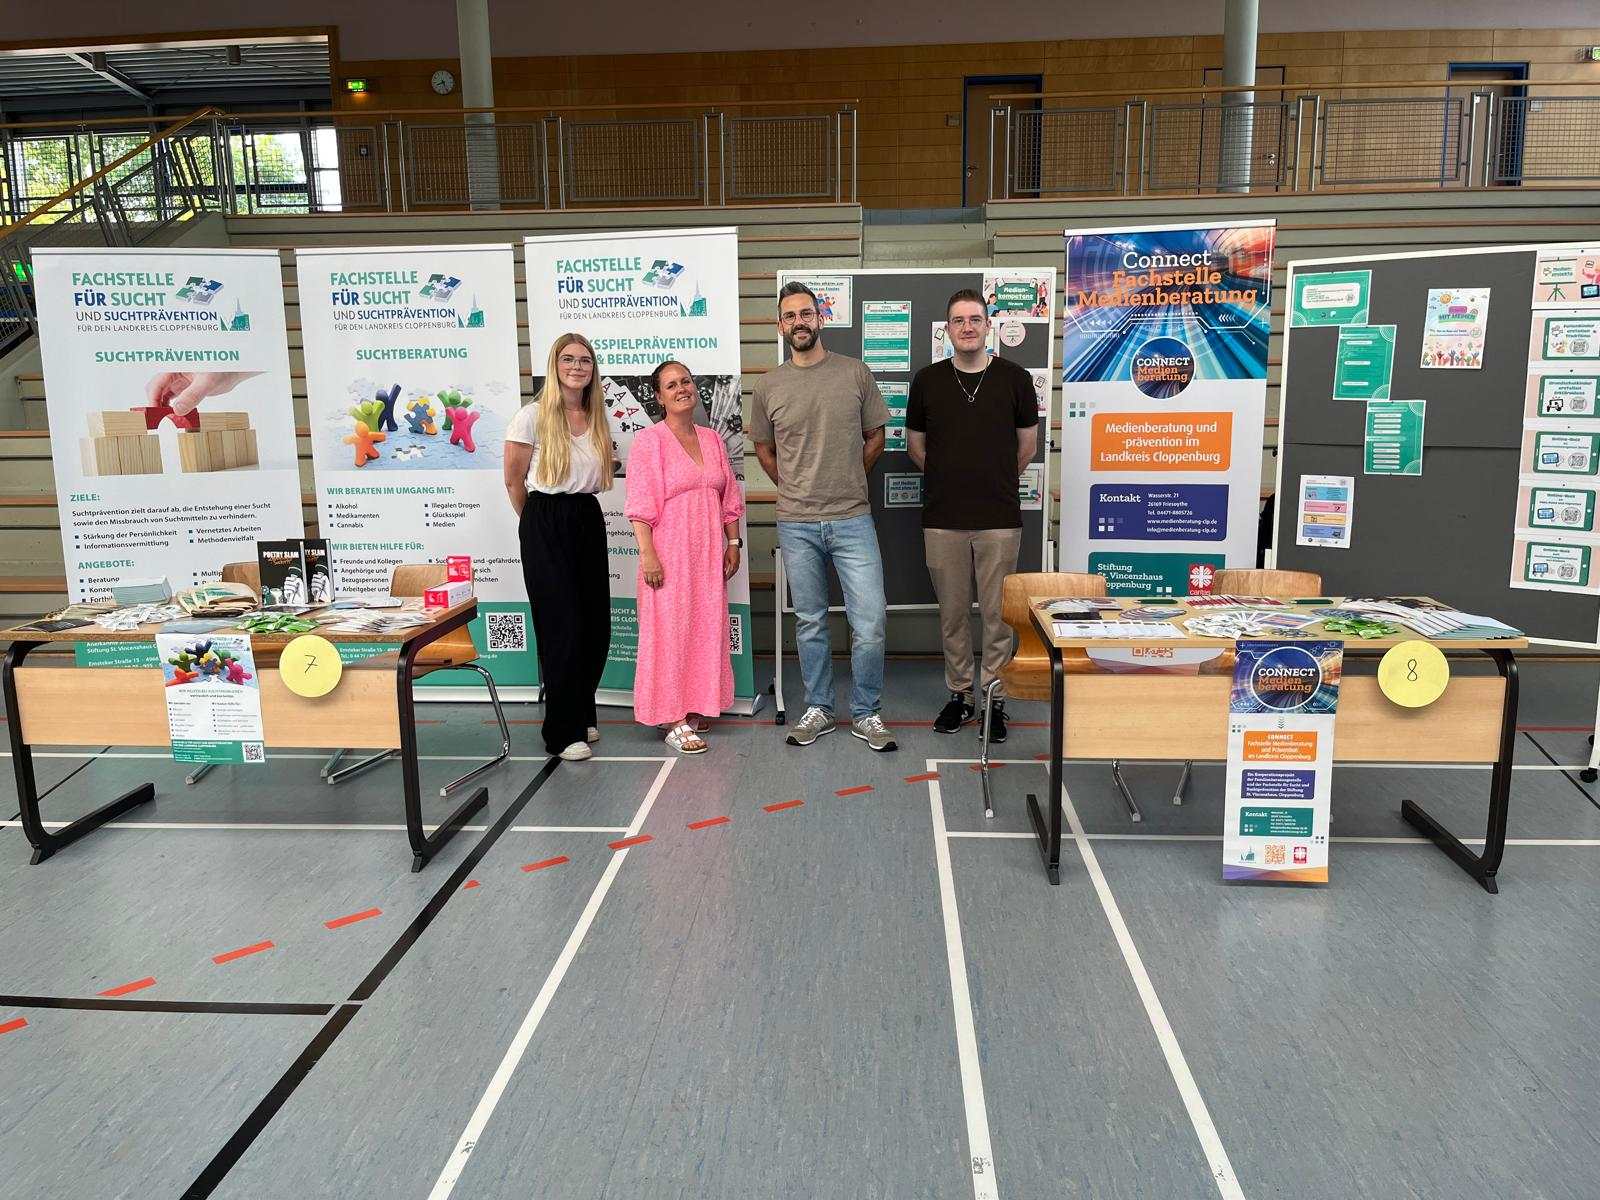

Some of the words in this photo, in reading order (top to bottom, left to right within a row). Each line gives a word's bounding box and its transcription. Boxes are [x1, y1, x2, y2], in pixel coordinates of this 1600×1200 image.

[557, 257, 641, 273] FACHSTELLE
[1124, 250, 1212, 268] Connect
[72, 272, 174, 286] FACHSTELLE
[330, 271, 418, 285] FACHSTELLE
[1112, 268, 1222, 288] Fachstelle
[558, 277, 584, 293] FÜR
[588, 278, 634, 292] SUCHT
[74, 290, 106, 306] FÜR
[111, 292, 166, 306] SUCHT
[332, 289, 359, 305] FÜR
[364, 291, 410, 304] SUCHT
[559, 299, 579, 309] UND
[582, 295, 678, 308] SUCHTPRÄVENTION
[1078, 288, 1257, 309] Medienberatung
[76, 311, 101, 321] UND
[104, 309, 217, 321] SUCHTPRÄVENTION
[334, 311, 355, 320] UND
[358, 307, 455, 319] SUCHTPRÄVENTION
[78, 324, 93, 332] FÜR
[590, 336, 717, 350] SSPIELPRÄVENTION
[96, 349, 239, 362] SUCHTPRÄVENTION
[356, 348, 467, 360] SUCHTBERATUNG
[597, 355, 604, 364] &
[608, 353, 674, 364] BERATUNG
[1137, 358, 1190, 366] CONNECT
[1138, 373, 1188, 382] beratung
[1106, 423, 1193, 435] Medienberatung
[1196, 422, 1216, 432] und
[1122, 437, 1182, 449] -prävention
[1186, 437, 1199, 446] im
[1101, 452, 1150, 462] Landkreis
[1153, 452, 1220, 464] Cloppenburg
[1100, 494, 1141, 503] Kontakt
[73, 509, 129, 517] Suchtprävention
[84, 541, 169, 549] Informationsvermittlung
[608, 547, 640, 556] PRÄVEN
[78, 559, 135, 569] ANGEBOTE:
[1098, 563, 1132, 572] Stiftung
[1110, 572, 1163, 581] Vincenzhaus
[1106, 582, 1151, 590] oppenburg
[304, 654, 318, 674] 7
[1406, 658, 1418, 682] 8
[1258, 667, 1315, 677] CONNECT
[1258, 683, 1312, 694] beratung
